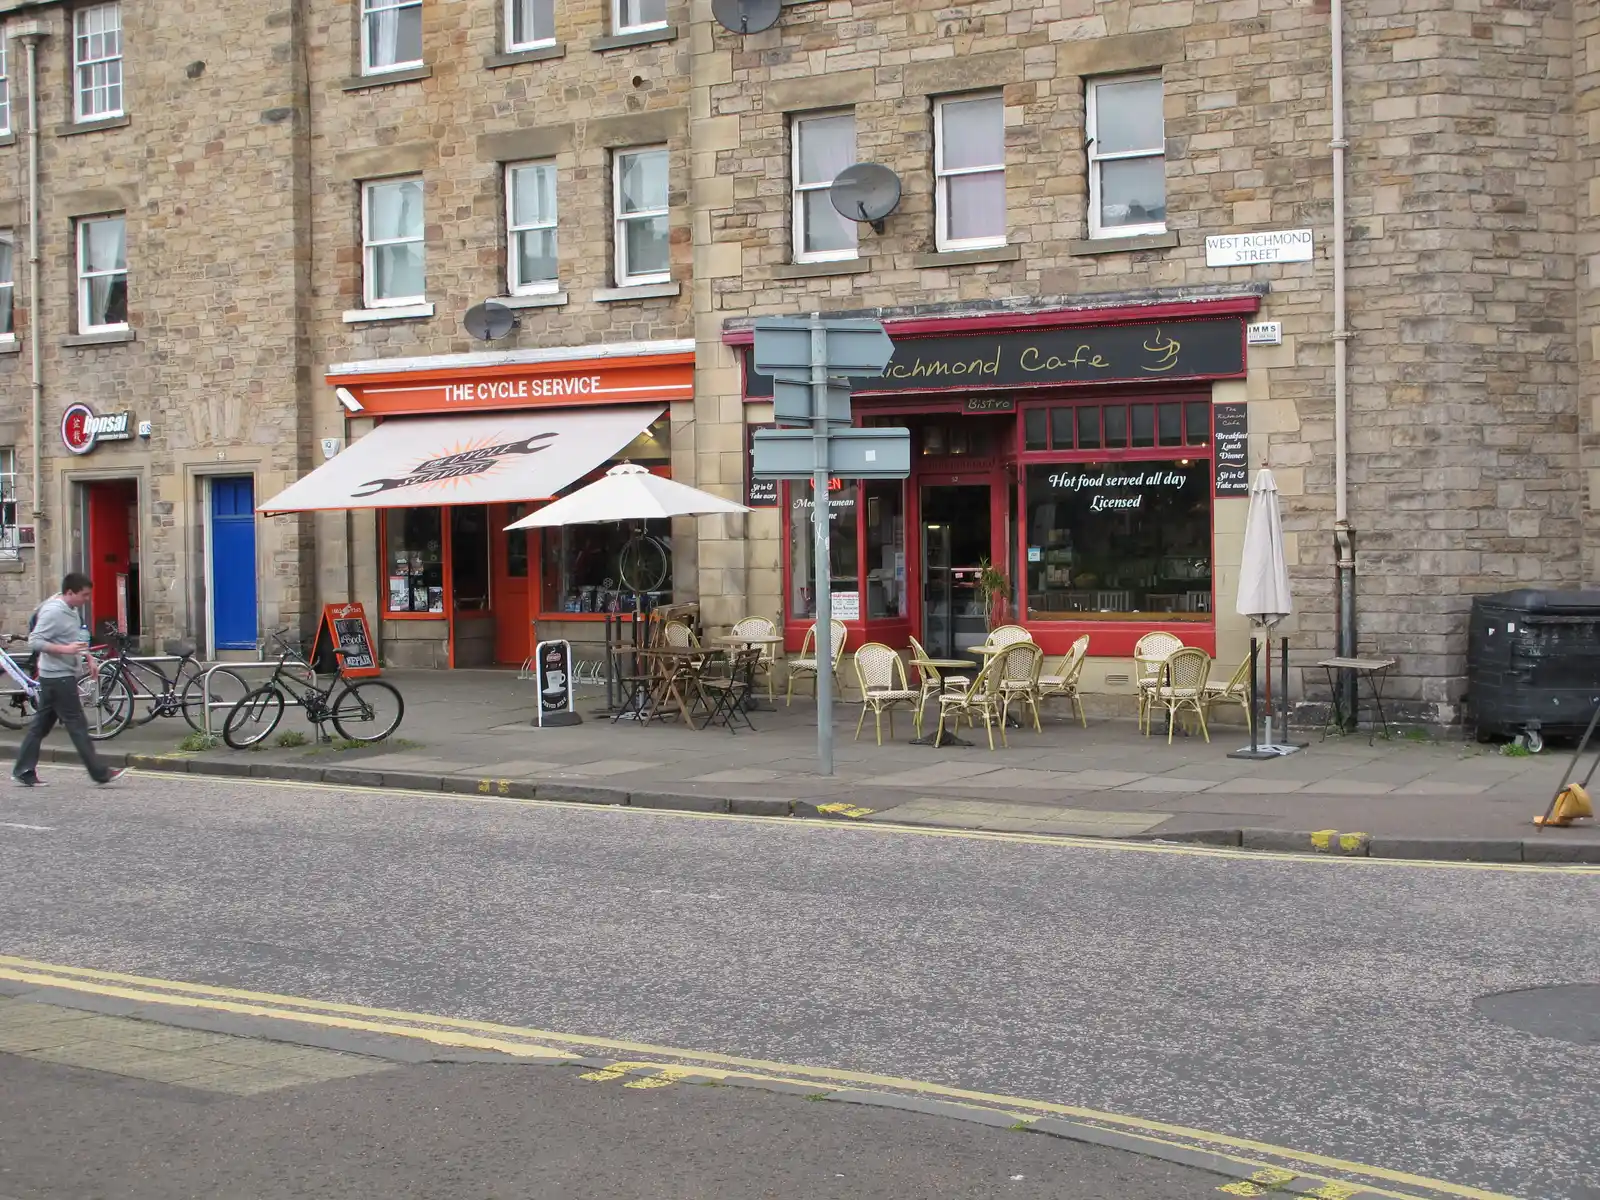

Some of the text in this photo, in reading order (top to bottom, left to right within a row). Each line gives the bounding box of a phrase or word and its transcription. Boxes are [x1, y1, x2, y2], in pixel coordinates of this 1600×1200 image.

[1207, 232, 1311, 249] WEST RICHMOND
[1235, 248, 1280, 261] STREET
[1248, 325, 1276, 333] IMMS
[883, 345, 1109, 378] ichmond Cafe
[444, 376, 600, 401] THE CYCLE SERVICE
[82, 412, 128, 434] bonsai
[1215, 431, 1248, 442] Breakfast
[1221, 442, 1242, 452] Lunch
[1219, 452, 1245, 460] Dinner
[1049, 472, 1187, 492] Hot food served all day
[1215, 481, 1249, 491] Take away
[1090, 495, 1142, 511] Licensed
